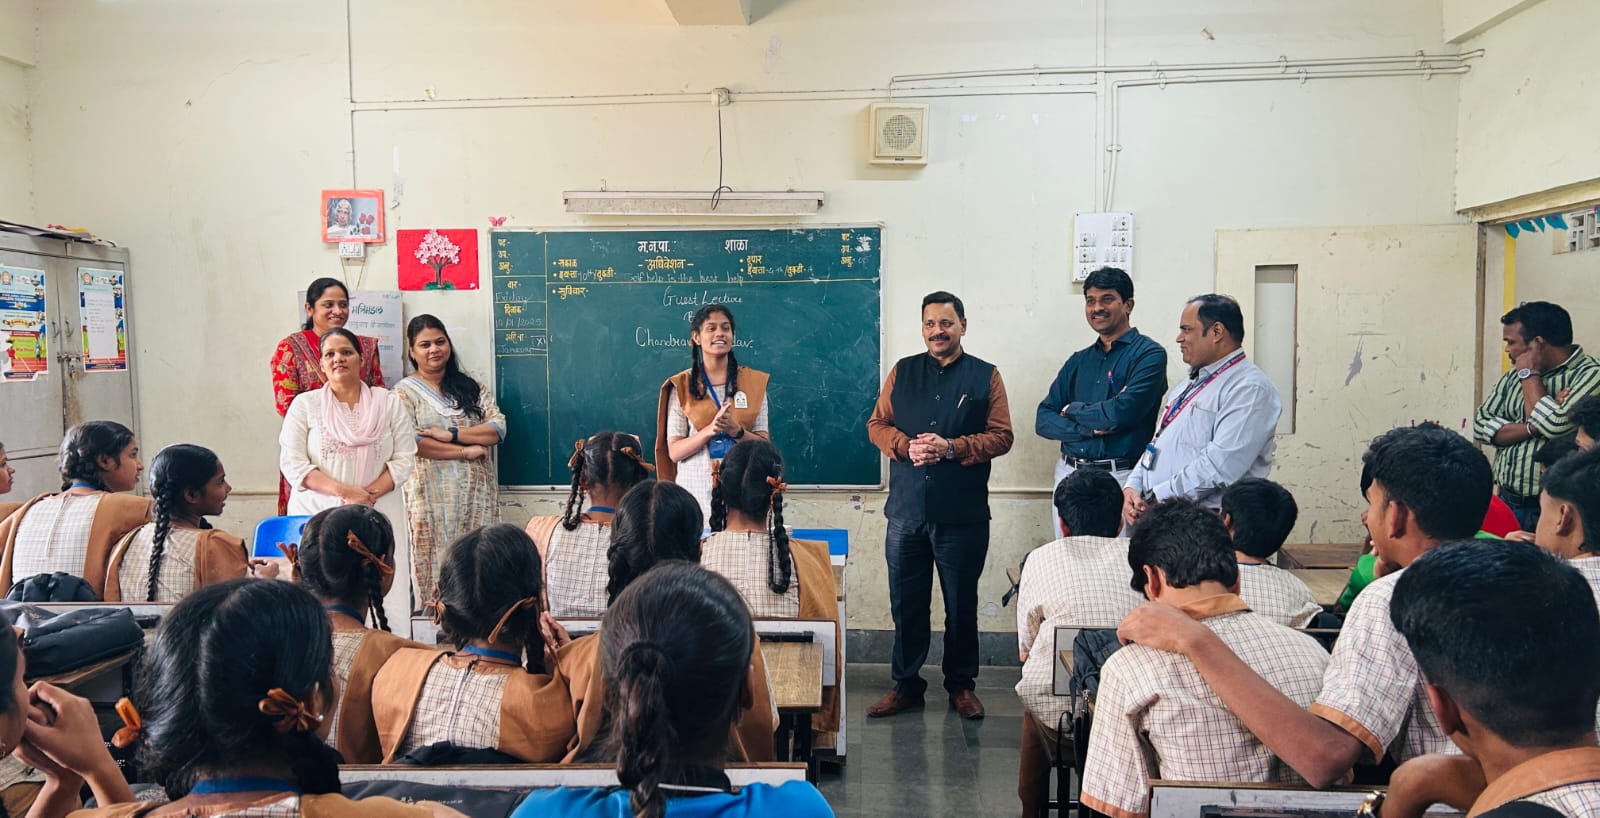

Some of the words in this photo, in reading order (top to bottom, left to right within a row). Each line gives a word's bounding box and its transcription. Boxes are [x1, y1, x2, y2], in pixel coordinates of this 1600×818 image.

[724, 240, 748, 253] शाळा
[662, 286, 698, 307] Guest
[701, 290, 744, 305] Lecture
